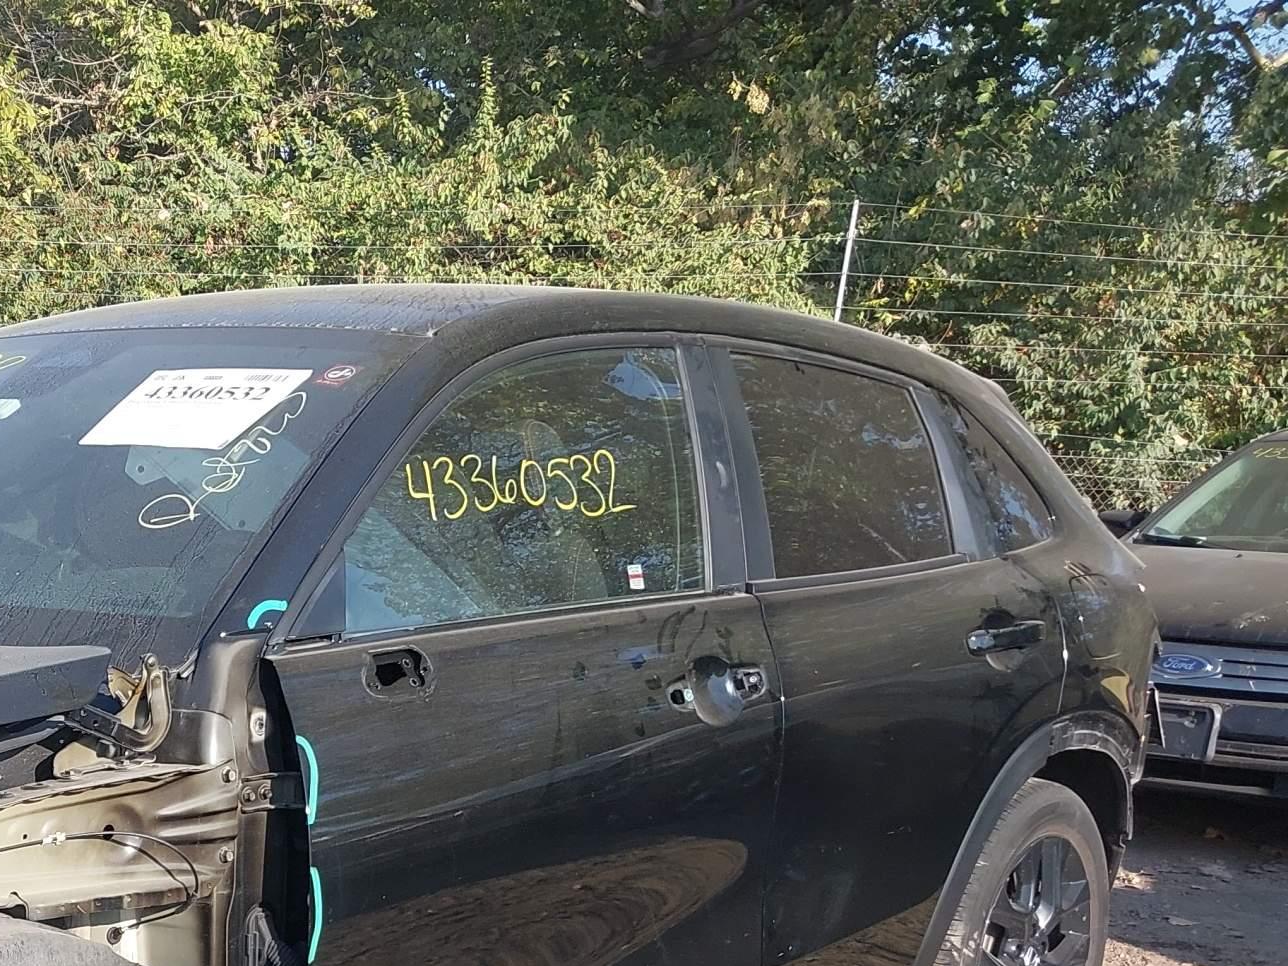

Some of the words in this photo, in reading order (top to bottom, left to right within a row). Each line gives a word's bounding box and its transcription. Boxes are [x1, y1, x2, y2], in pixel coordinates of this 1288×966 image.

[144, 386, 271, 400] 43360532
[406, 450, 637, 521] 43360532
[1162, 657, 1196, 671] Ford
